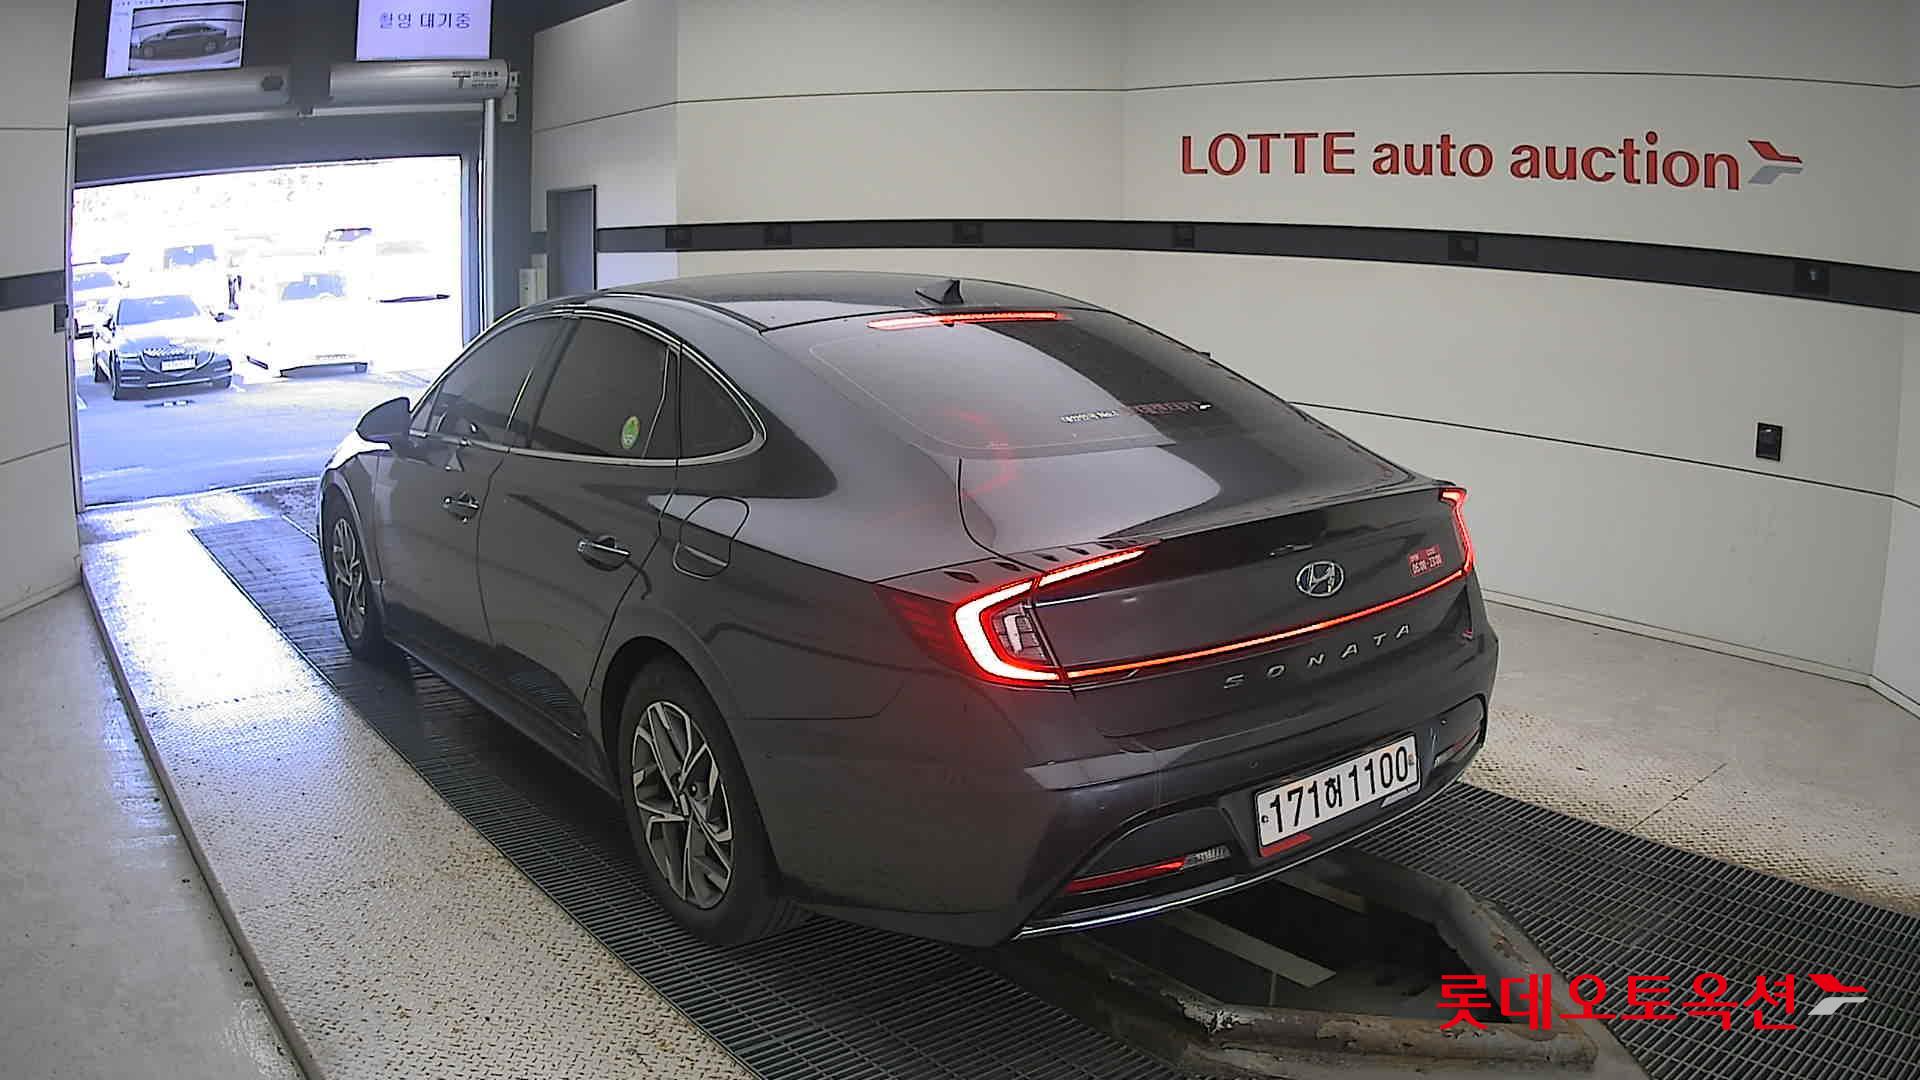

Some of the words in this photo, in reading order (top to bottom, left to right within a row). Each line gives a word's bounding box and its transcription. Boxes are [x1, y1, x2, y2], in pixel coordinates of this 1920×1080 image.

[420, 11, 472, 29] 대기중
[1181, 131, 1356, 176] LOTTE
[1371, 133, 1493, 178] auto
[1509, 131, 1740, 191] auction
[1223, 623, 1410, 690] SONATA
